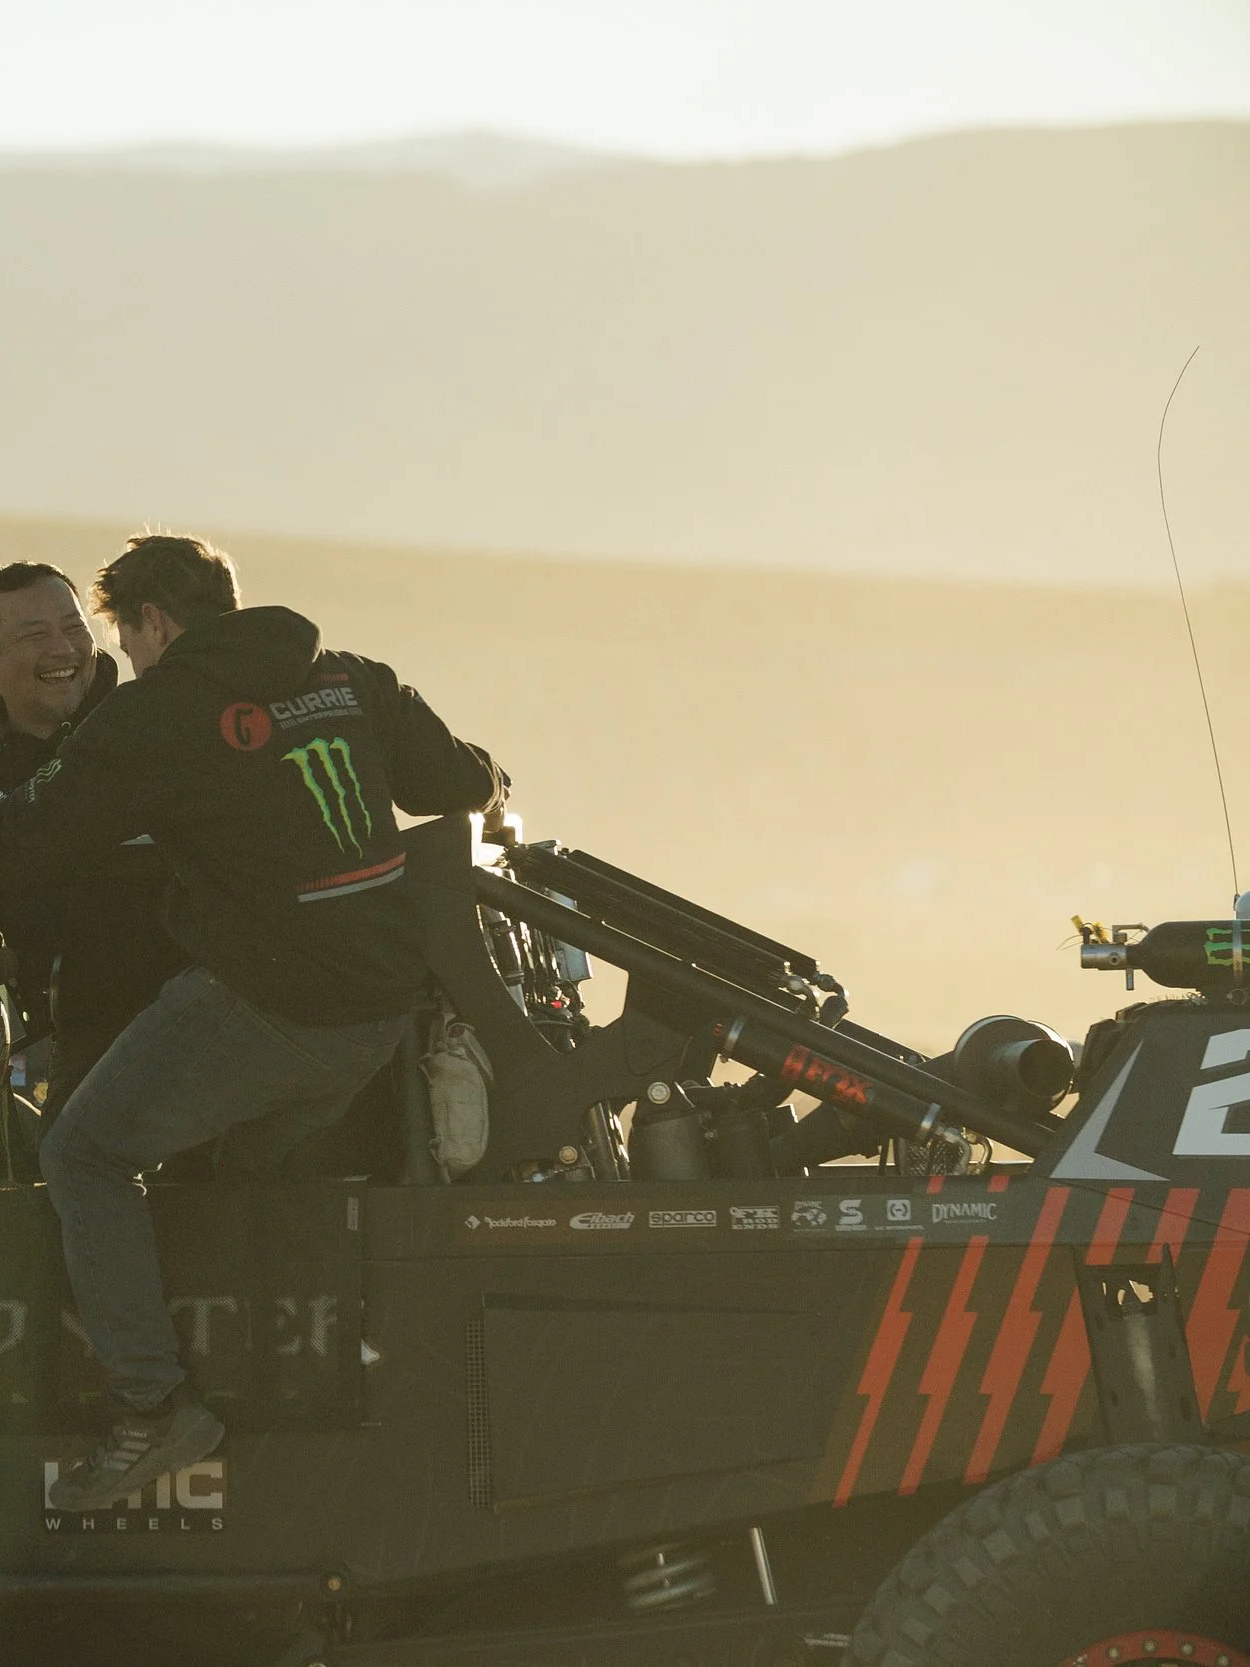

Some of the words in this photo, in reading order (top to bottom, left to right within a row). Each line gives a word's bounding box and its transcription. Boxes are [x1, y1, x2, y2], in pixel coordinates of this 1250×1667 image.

[269, 687, 358, 720] CURRIE
[570, 1212, 636, 1229] Eibach
[651, 1212, 715, 1226] sparco
[932, 1203, 997, 1223] DYNAMIC
[45, 1518, 223, 1530] WHEELS
